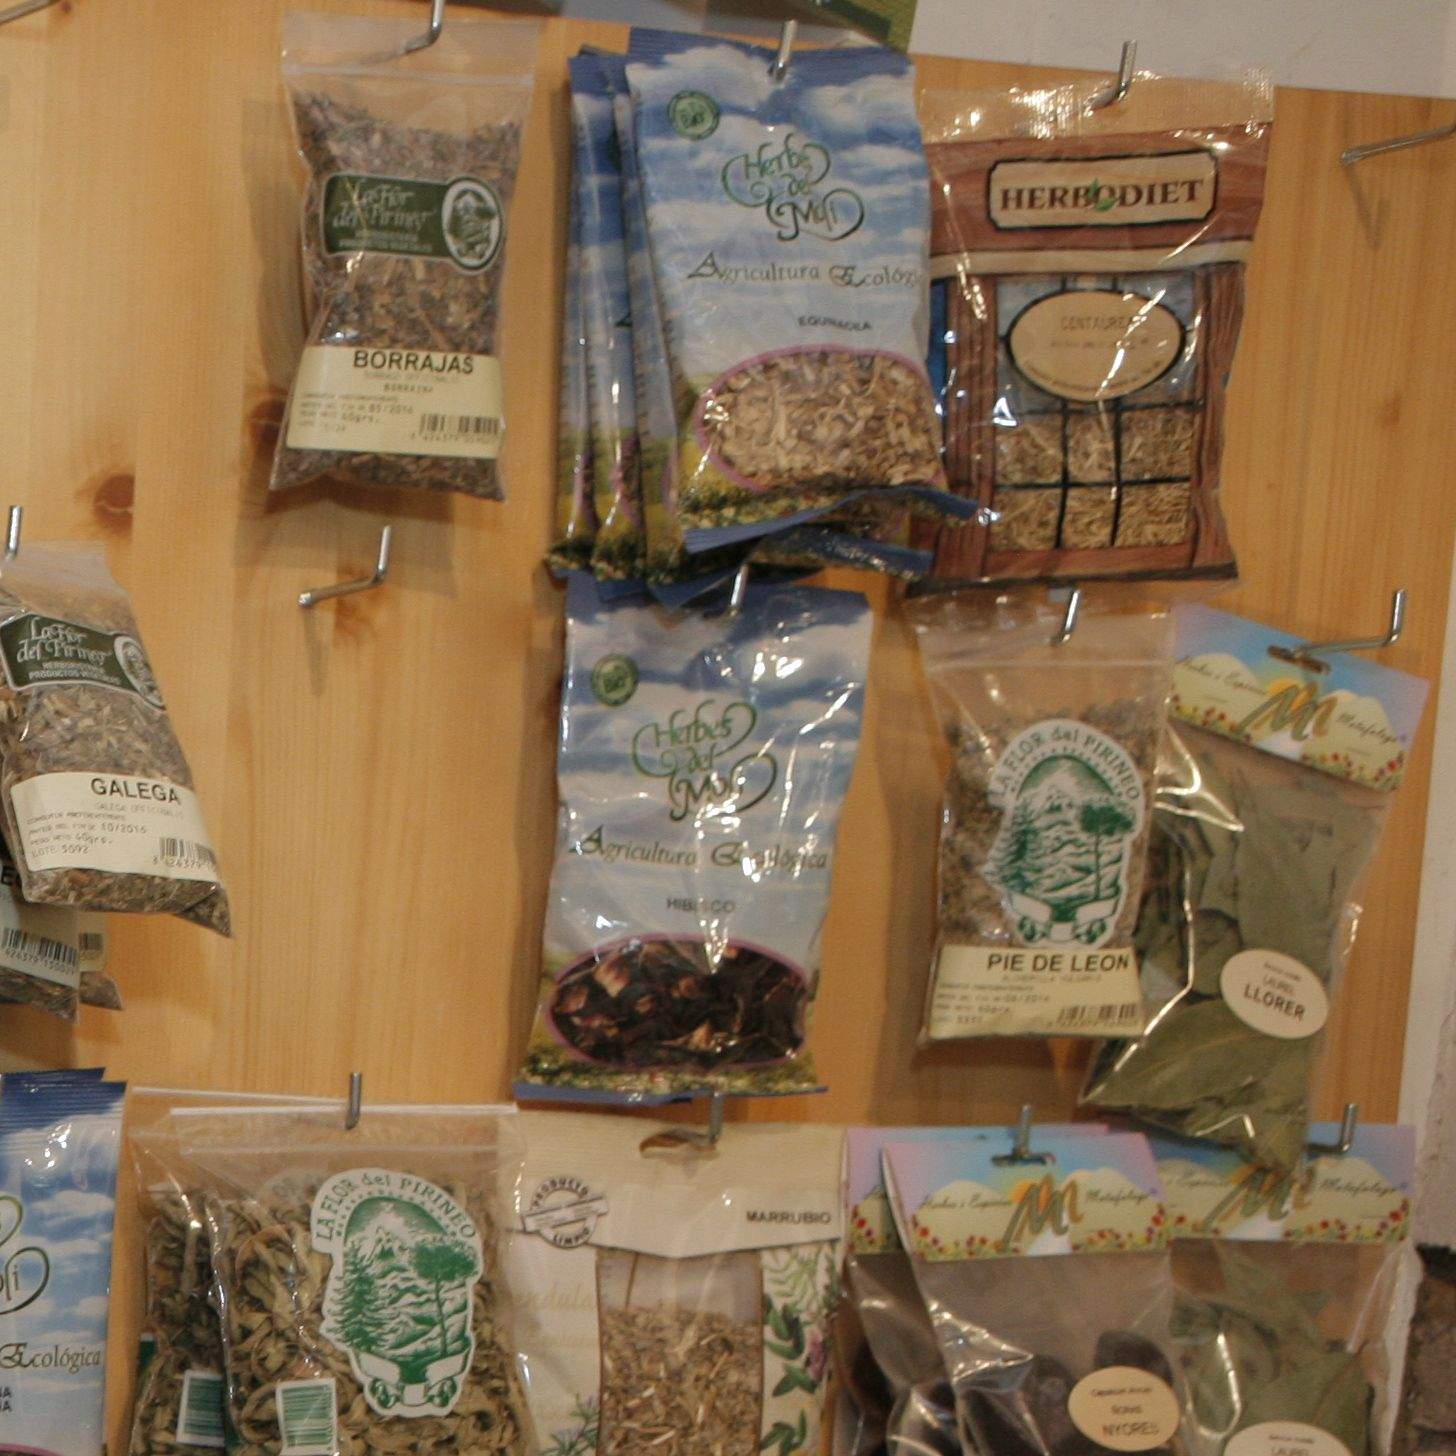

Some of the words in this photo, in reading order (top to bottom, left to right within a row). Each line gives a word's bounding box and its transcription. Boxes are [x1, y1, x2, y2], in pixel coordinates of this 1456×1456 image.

[1000, 179, 1205, 212] HERBODIET
[688, 251, 820, 285] Agricultura
[353, 350, 474, 374] BORRAJAS
[91, 778, 181, 805] GALEGA
[988, 954, 1024, 972] PIE
[1032, 954, 1063, 972] DE
[1070, 954, 1130, 972] LEON
[1243, 983, 1306, 1022] LLORER
[320, 1174, 355, 1217] FLOR
[399, 1177, 478, 1240] PIRINEO
[747, 1210, 832, 1225] MARRUBIO
